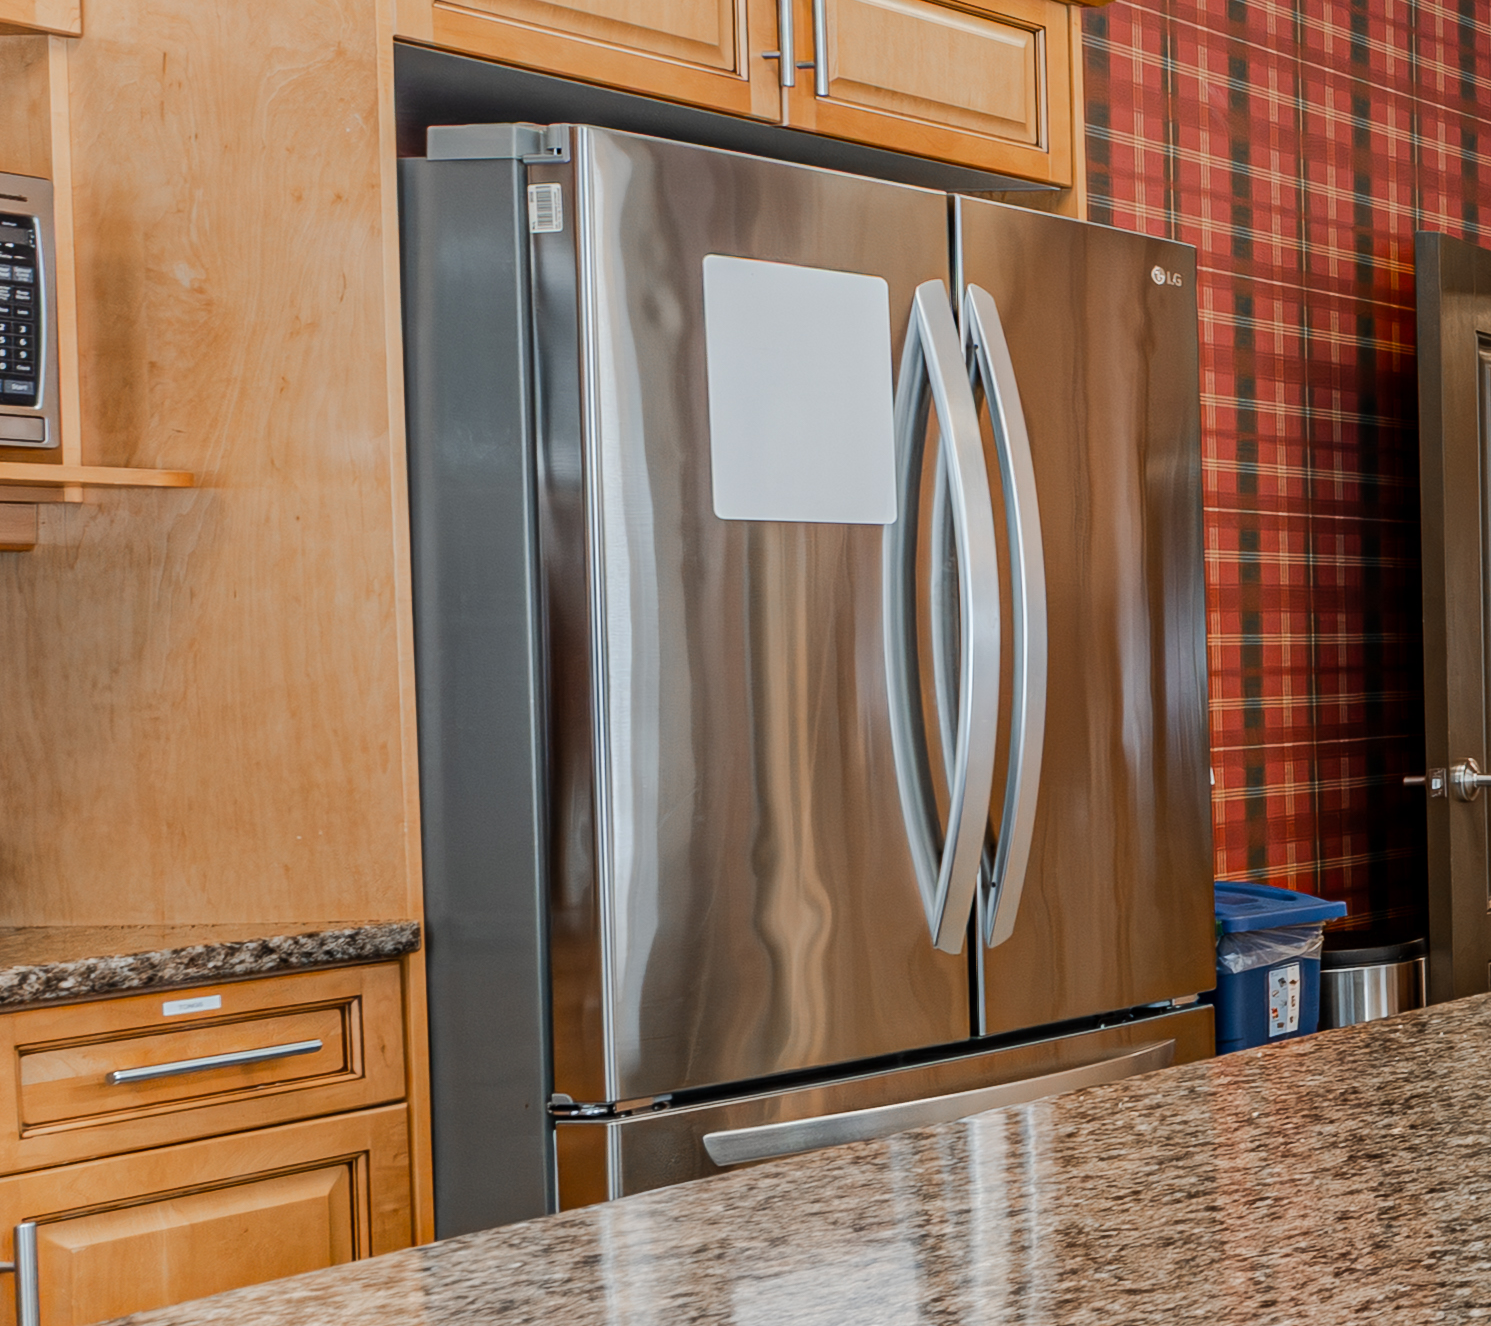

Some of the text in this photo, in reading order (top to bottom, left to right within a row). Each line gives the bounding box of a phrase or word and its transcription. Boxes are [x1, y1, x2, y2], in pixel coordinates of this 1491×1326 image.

[1166, 271, 1183, 287] LG
[19, 325, 26, 334] 3
[19, 338, 27, 346] 6
[19, 350, 27, 359] 9
